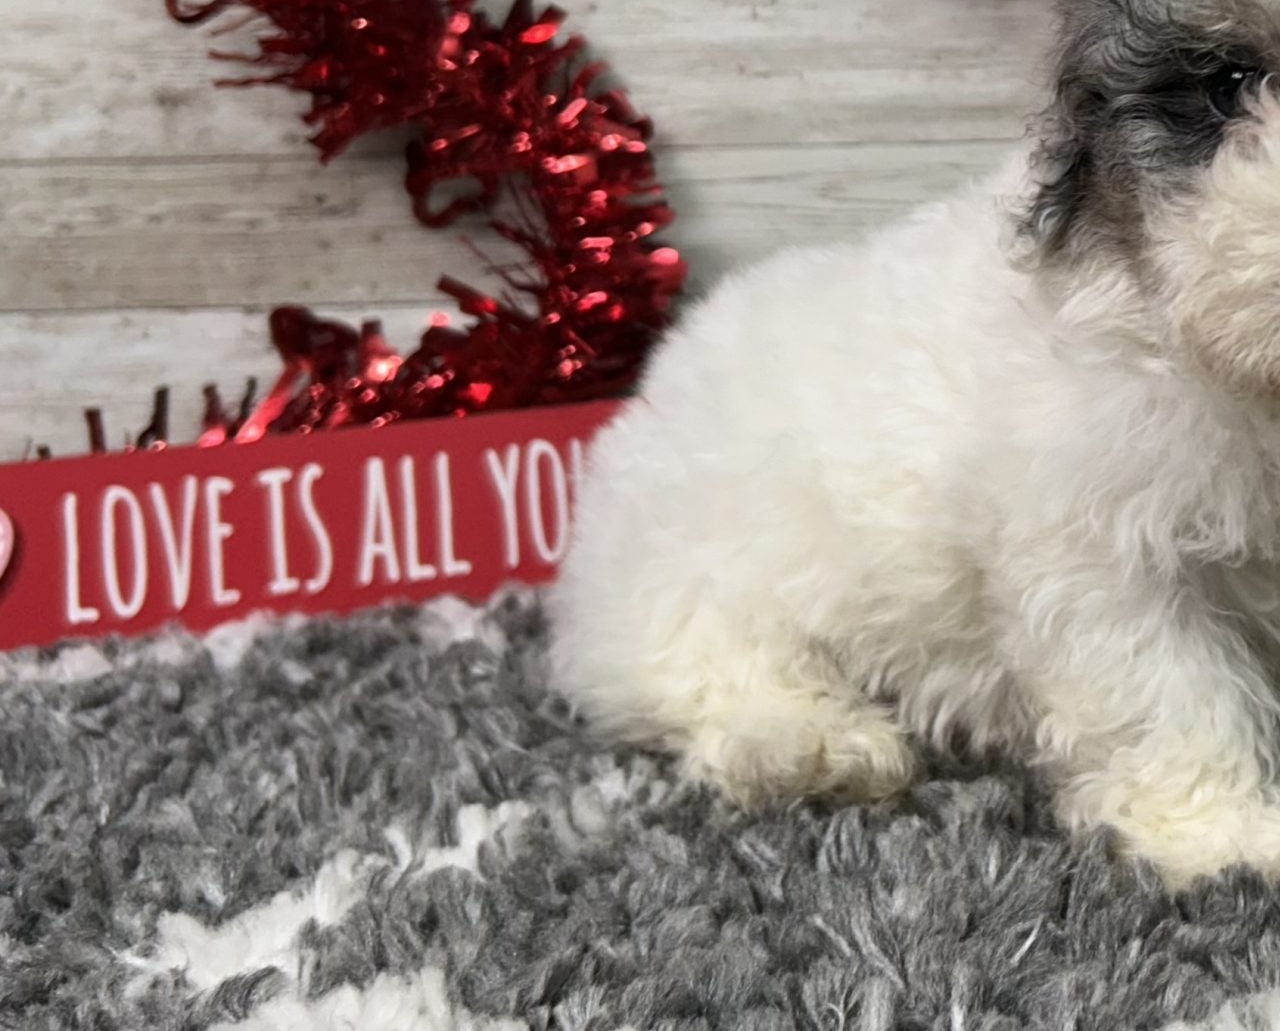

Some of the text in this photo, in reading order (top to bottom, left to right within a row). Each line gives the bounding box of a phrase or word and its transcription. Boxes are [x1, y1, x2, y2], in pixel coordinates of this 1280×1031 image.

[63, 474, 241, 624] LOVE
[257, 462, 333, 595] IS
[359, 451, 472, 587] ALL
